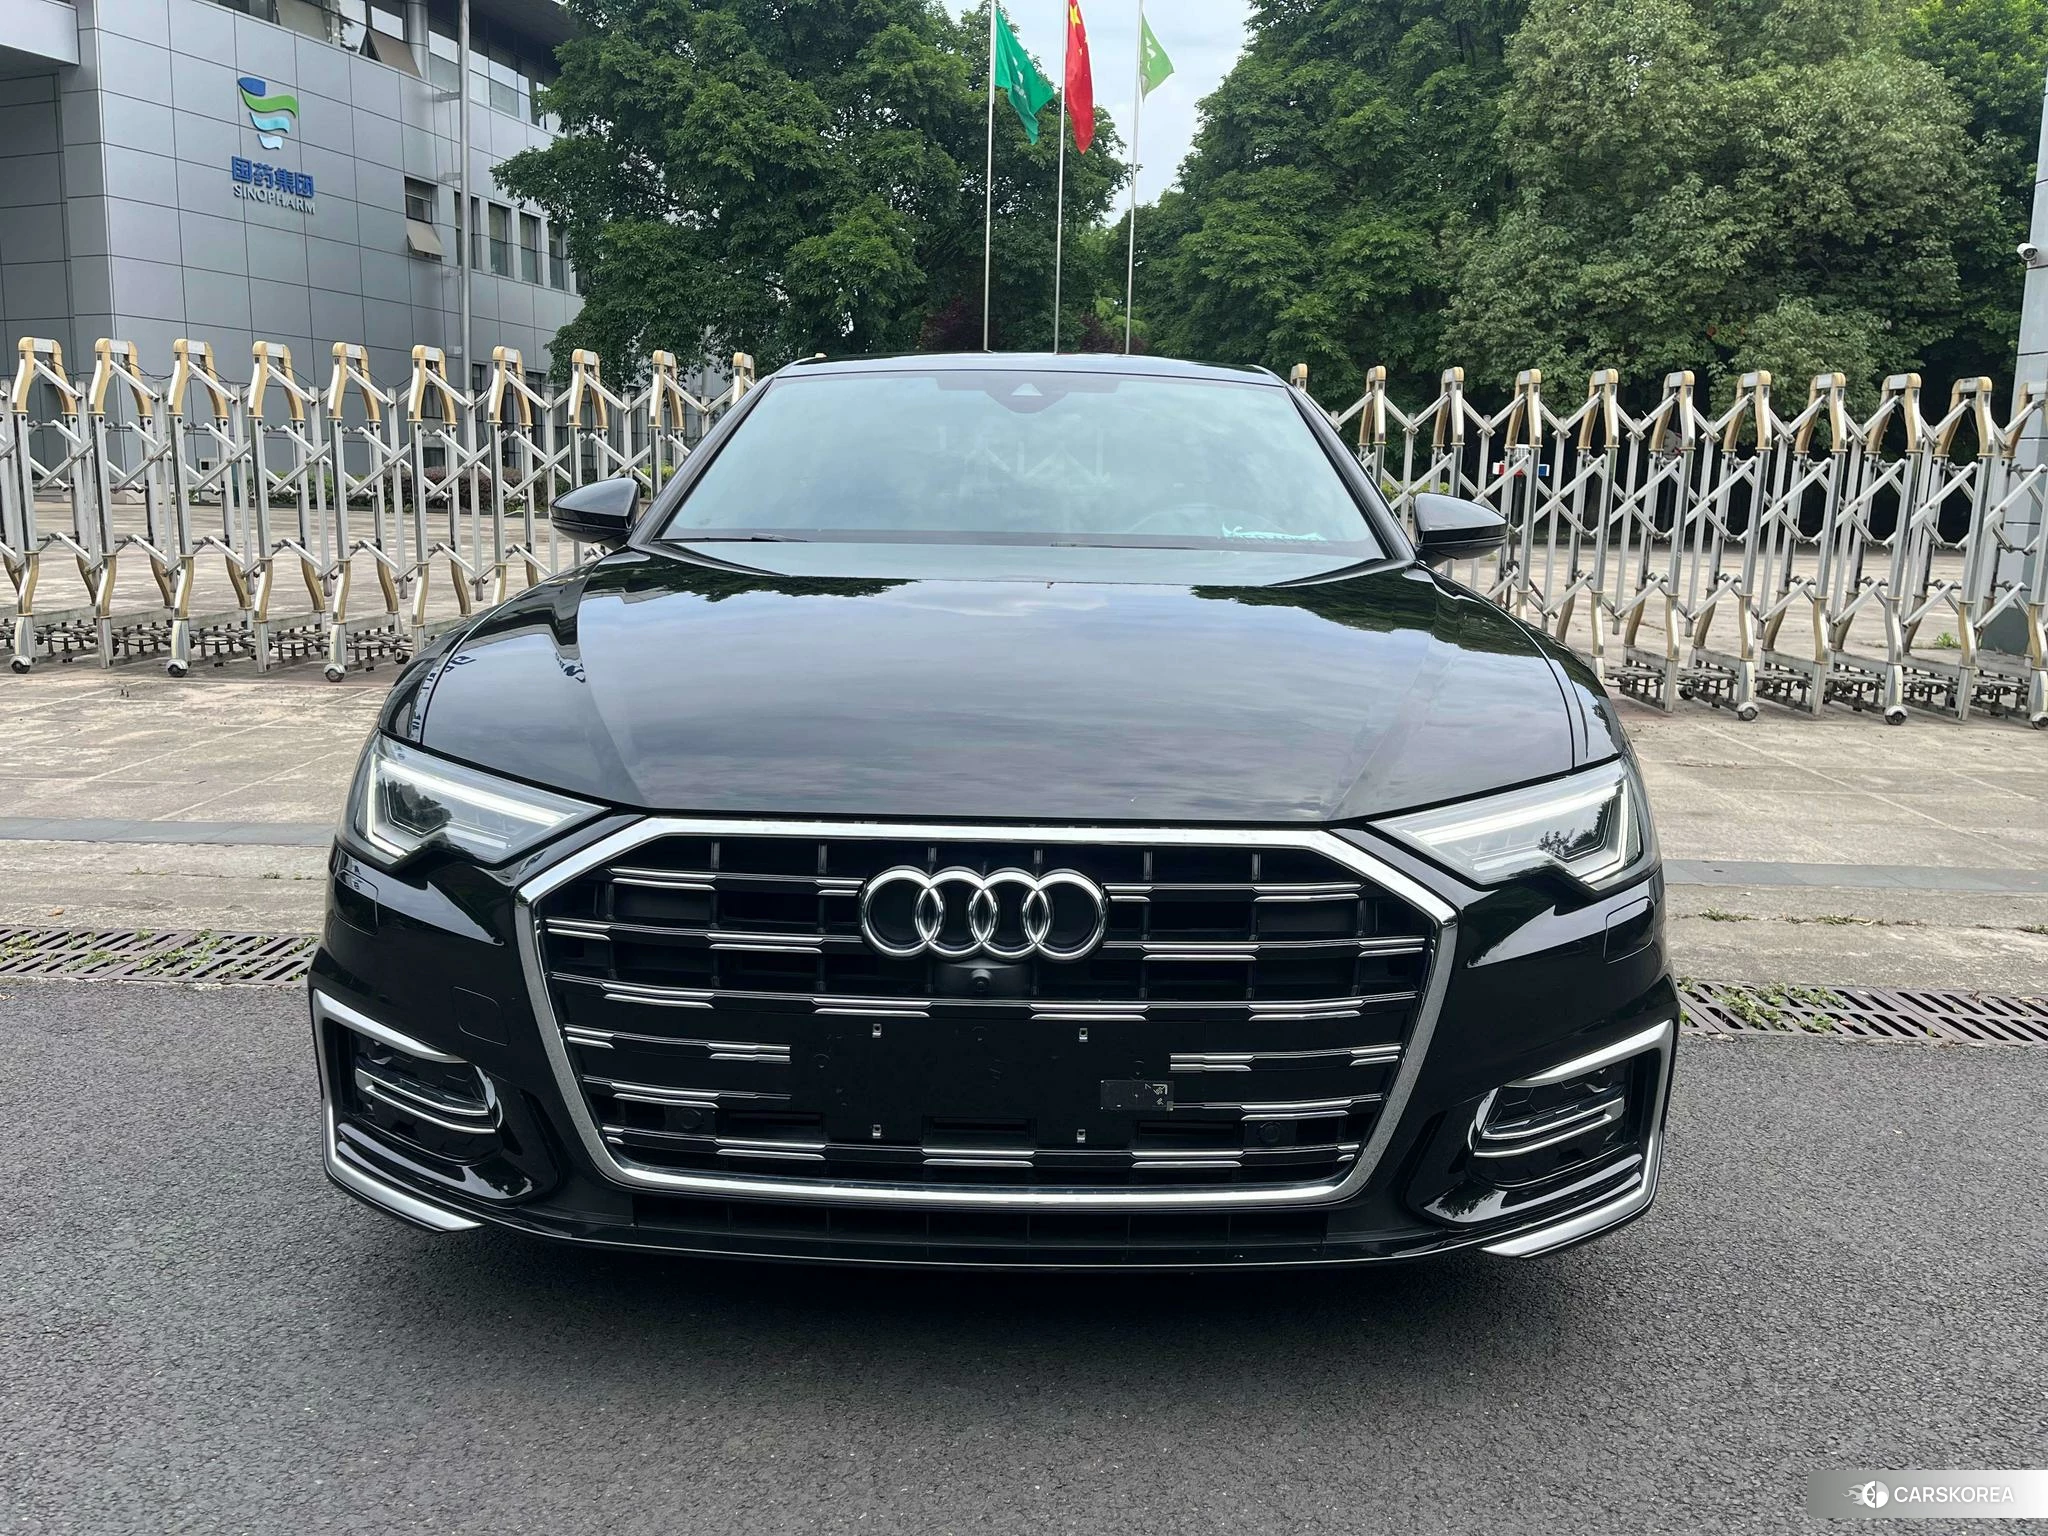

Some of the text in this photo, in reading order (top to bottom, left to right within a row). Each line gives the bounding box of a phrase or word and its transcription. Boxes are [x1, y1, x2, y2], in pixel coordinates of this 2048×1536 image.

[232, 156, 314, 198] 国药集团
[233, 184, 316, 214] SINOPHARM
